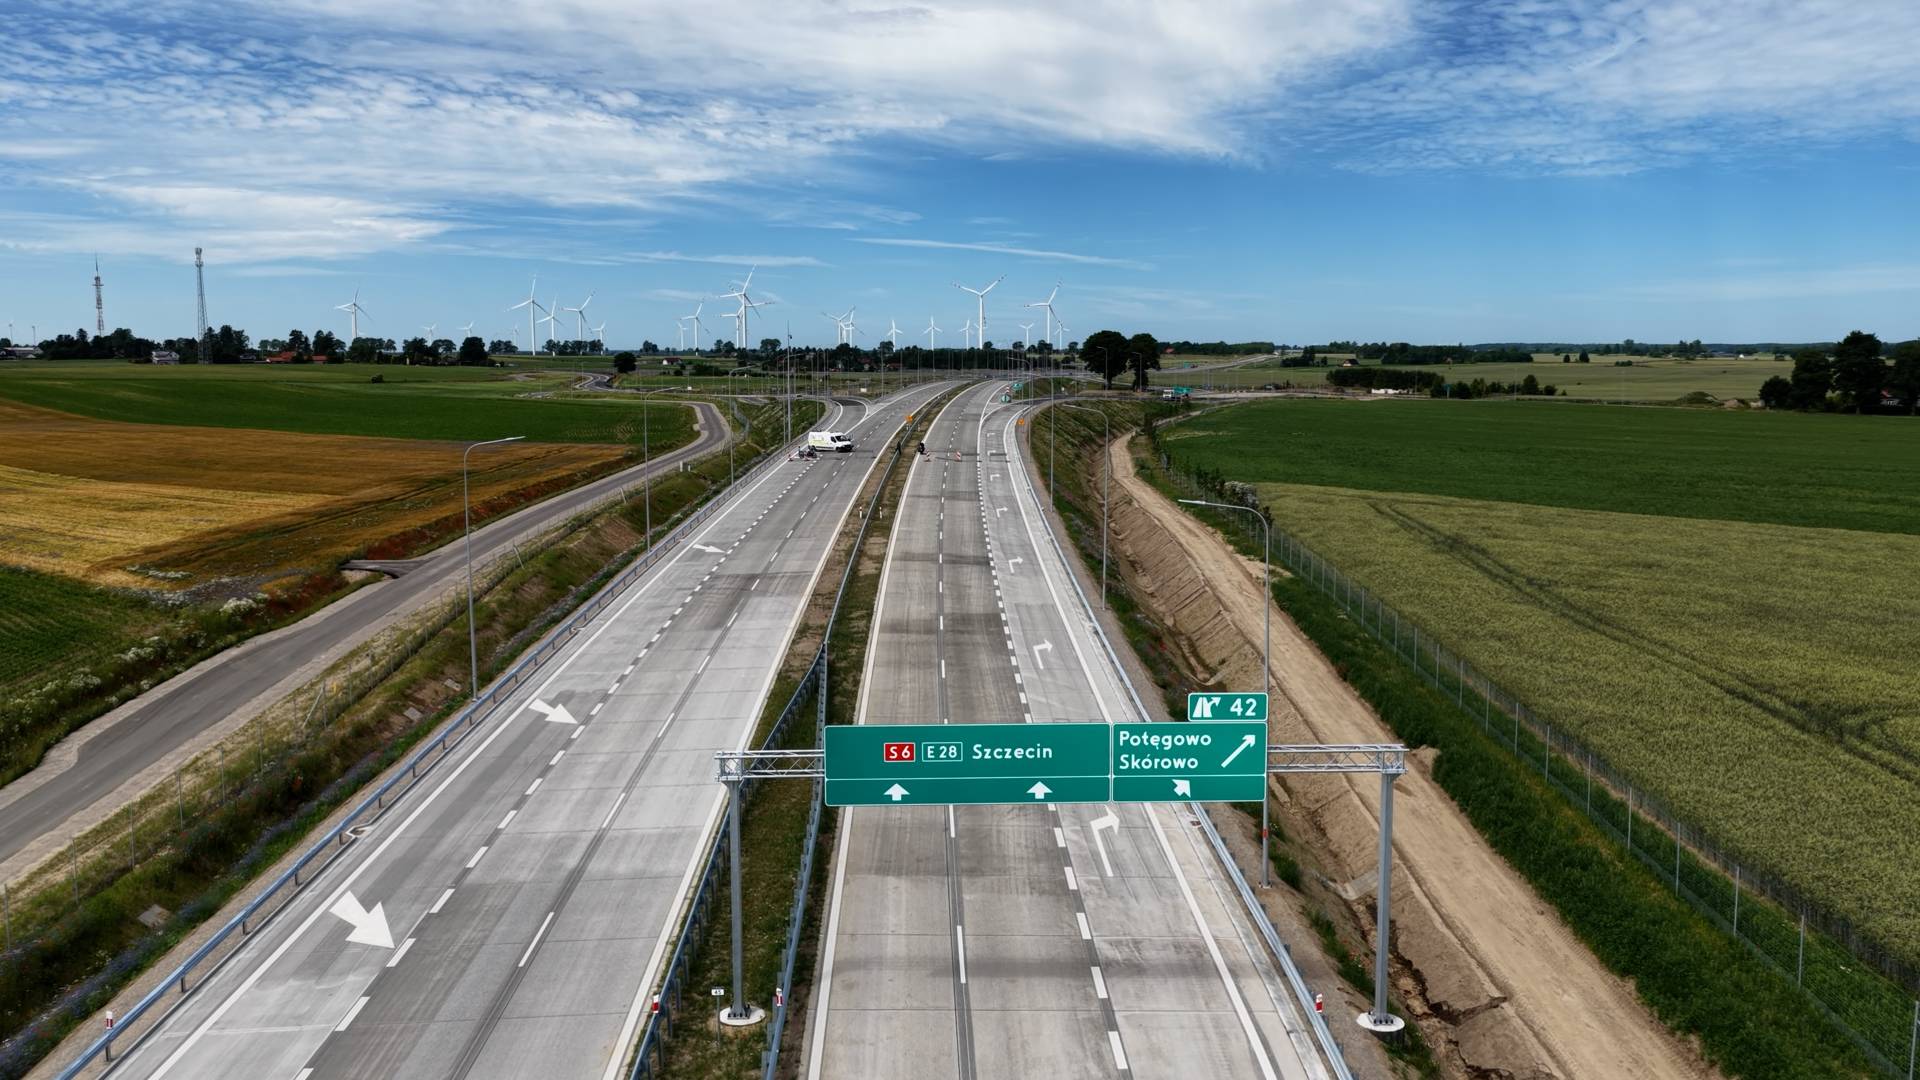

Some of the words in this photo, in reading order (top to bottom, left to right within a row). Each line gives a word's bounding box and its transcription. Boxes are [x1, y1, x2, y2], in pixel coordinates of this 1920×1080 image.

[1230, 698, 1257, 717] 42
[1119, 730, 1212, 750] Potęgowo
[972, 743, 1053, 760] Szczecin
[1119, 754, 1198, 770] Skórowo
